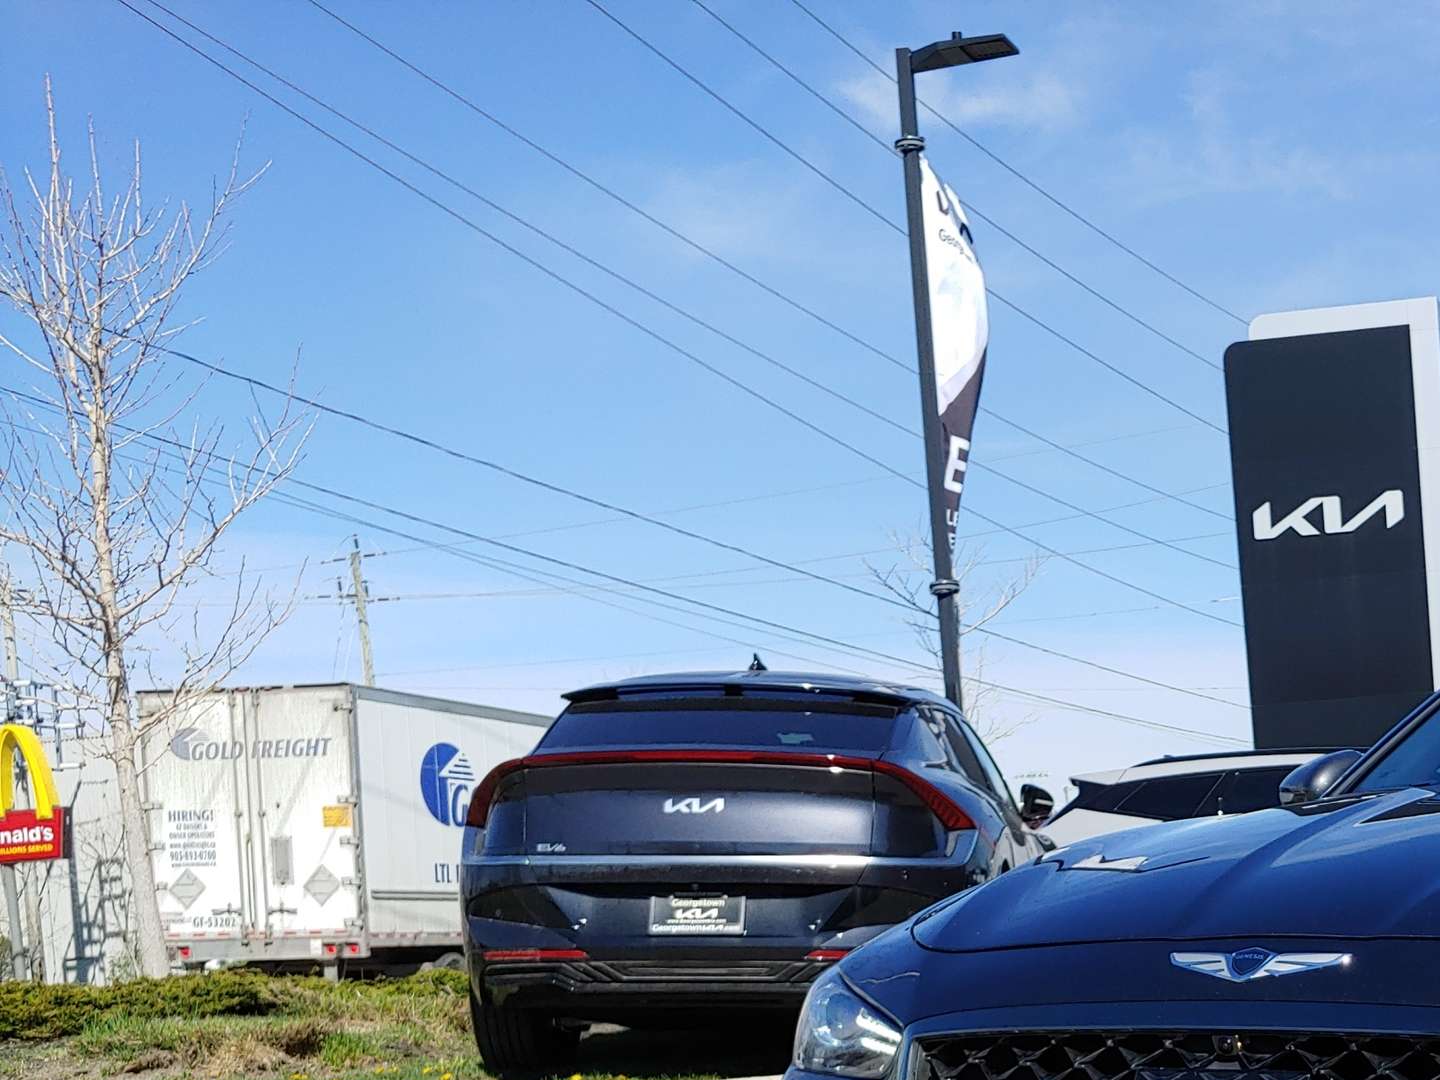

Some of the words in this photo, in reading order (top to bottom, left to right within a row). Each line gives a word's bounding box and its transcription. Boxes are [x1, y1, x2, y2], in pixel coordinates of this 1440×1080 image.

[1252, 489, 1404, 540] KIA
[191, 741, 244, 761] GOLD
[251, 737, 332, 759] FREIGHT
[663, 797, 724, 813] KIA
[168, 809, 214, 822] HIRING!
[0, 825, 54, 845] nald's
[536, 843, 567, 852] EV6
[434, 862, 451, 883] LTL
[673, 908, 719, 919] KIA
